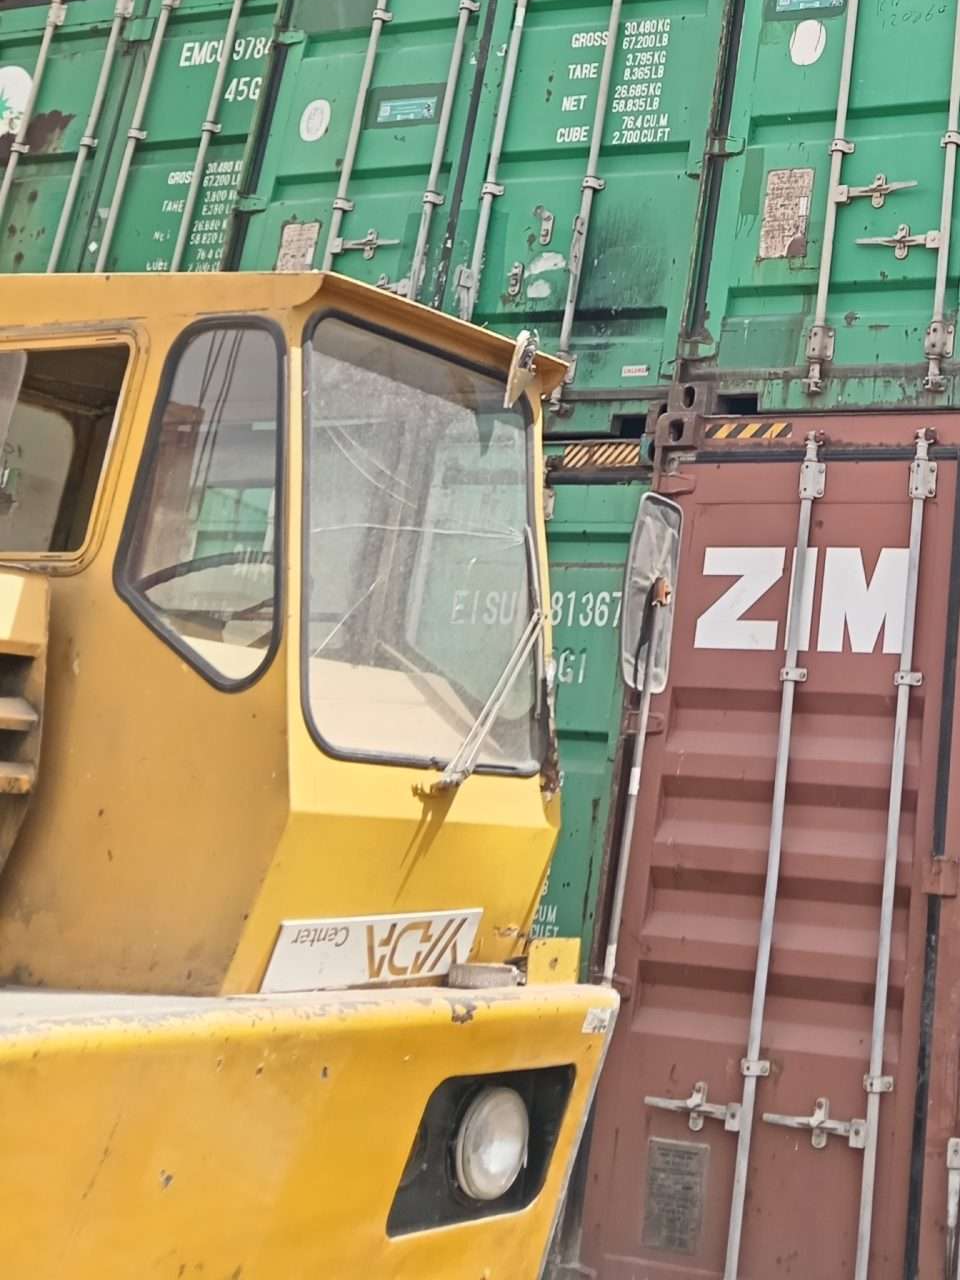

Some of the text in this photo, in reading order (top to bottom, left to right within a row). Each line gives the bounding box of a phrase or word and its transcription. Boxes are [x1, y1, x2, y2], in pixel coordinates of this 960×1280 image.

[571, 18, 670, 48] GROSS 30.480 KG
[623, 33, 668, 49] 67.200 LB
[568, 51, 666, 79] TARE 3.795 KG
[624, 65, 664, 80] 8.365 LB
[561, 82, 662, 112] NET 26.685 KG
[612, 97, 659, 113] 58.835 LB
[556, 126, 589, 143] CUBE
[622, 115, 643, 129] 76.4
[612, 128, 670, 145] 2.700 CU.FT
[450, 589, 517, 626] EISU
[694, 546, 912, 653] ZIM
[290, 925, 349, 947] Center
